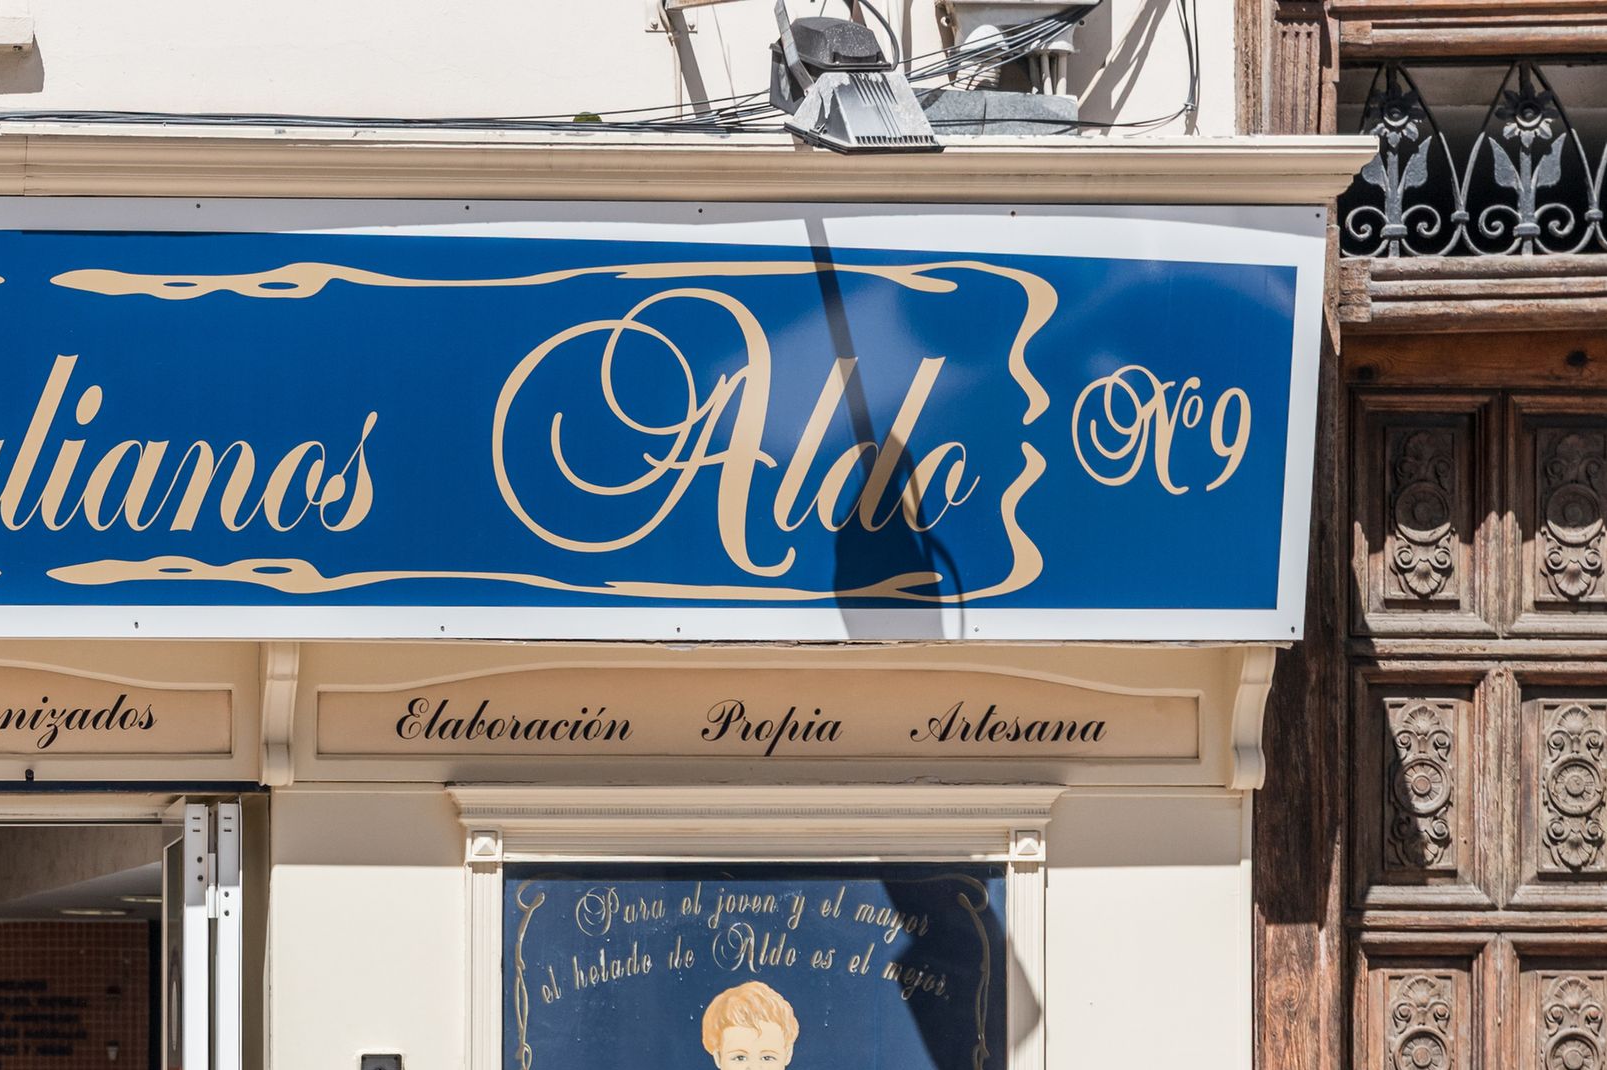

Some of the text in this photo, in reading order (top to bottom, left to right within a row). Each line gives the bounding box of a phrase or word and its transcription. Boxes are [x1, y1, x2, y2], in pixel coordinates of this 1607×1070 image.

[492, 287, 980, 577] Aldo
[1206, 387, 1251, 492] 9
[395, 697, 1107, 757] Elaboración Propia Artesana
[575, 881, 931, 944] Para el joven y el mayor
[541, 968, 562, 1004] el
[573, 936, 653, 991] helado
[668, 935, 695, 970] de
[712, 921, 797, 973] Aldo
[811, 949, 836, 970] es
[848, 942, 875, 974] el
